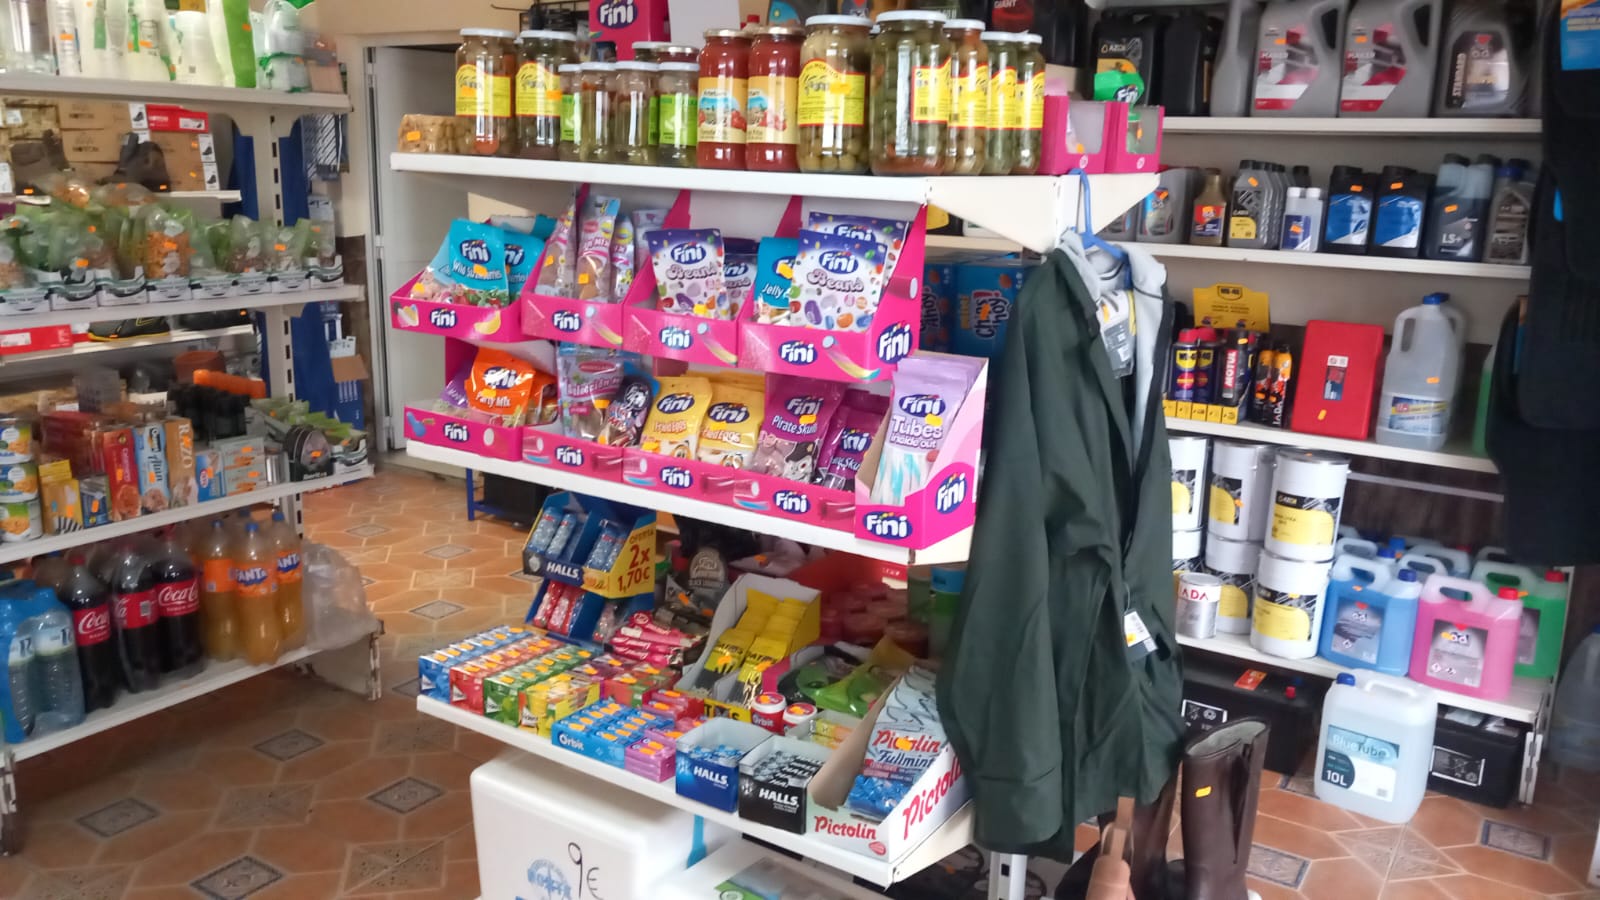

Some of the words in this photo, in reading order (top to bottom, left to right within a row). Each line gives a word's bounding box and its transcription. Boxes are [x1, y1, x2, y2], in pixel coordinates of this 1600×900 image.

[599, 1, 634, 26] Fini
[837, 224, 873, 243] Fini
[1442, 233, 1462, 244] LS+
[461, 242, 489, 262] Fini
[672, 243, 705, 264] Fini
[665, 263, 717, 281] Beans
[820, 251, 857, 275] Fini
[762, 282, 785, 299] Jelly
[806, 269, 864, 293] Beans
[429, 308, 457, 328] Fini
[553, 310, 581, 332] Fini
[660, 327, 691, 349] Fini
[877, 324, 912, 362] Fini
[781, 342, 816, 364] Fini
[1223, 350, 1237, 388] MOTUL
[495, 395, 511, 408] Mix
[657, 393, 694, 412] Fini
[787, 396, 823, 415] Fini
[899, 395, 943, 417] Fini
[709, 404, 747, 423] Fini
[443, 423, 470, 441] Fini
[771, 414, 798, 434] Pirate
[891, 415, 943, 439] Tubes
[890, 433, 918, 448] inside
[917, 438, 937, 450] out
[555, 446, 583, 466] Fini
[660, 466, 691, 487] Fini
[774, 491, 808, 512] Fini
[935, 475, 967, 511] Fini
[866, 513, 911, 539] Fini
[628, 544, 651, 570] 2x
[546, 561, 580, 580] HALLS
[752, 714, 775, 728] Orbit
[558, 732, 585, 752] Orbit
[693, 766, 729, 787] HALLS
[1325, 769, 1348, 788] 10L
[758, 788, 799, 808] HALLS
[813, 815, 877, 841] Pictolin
